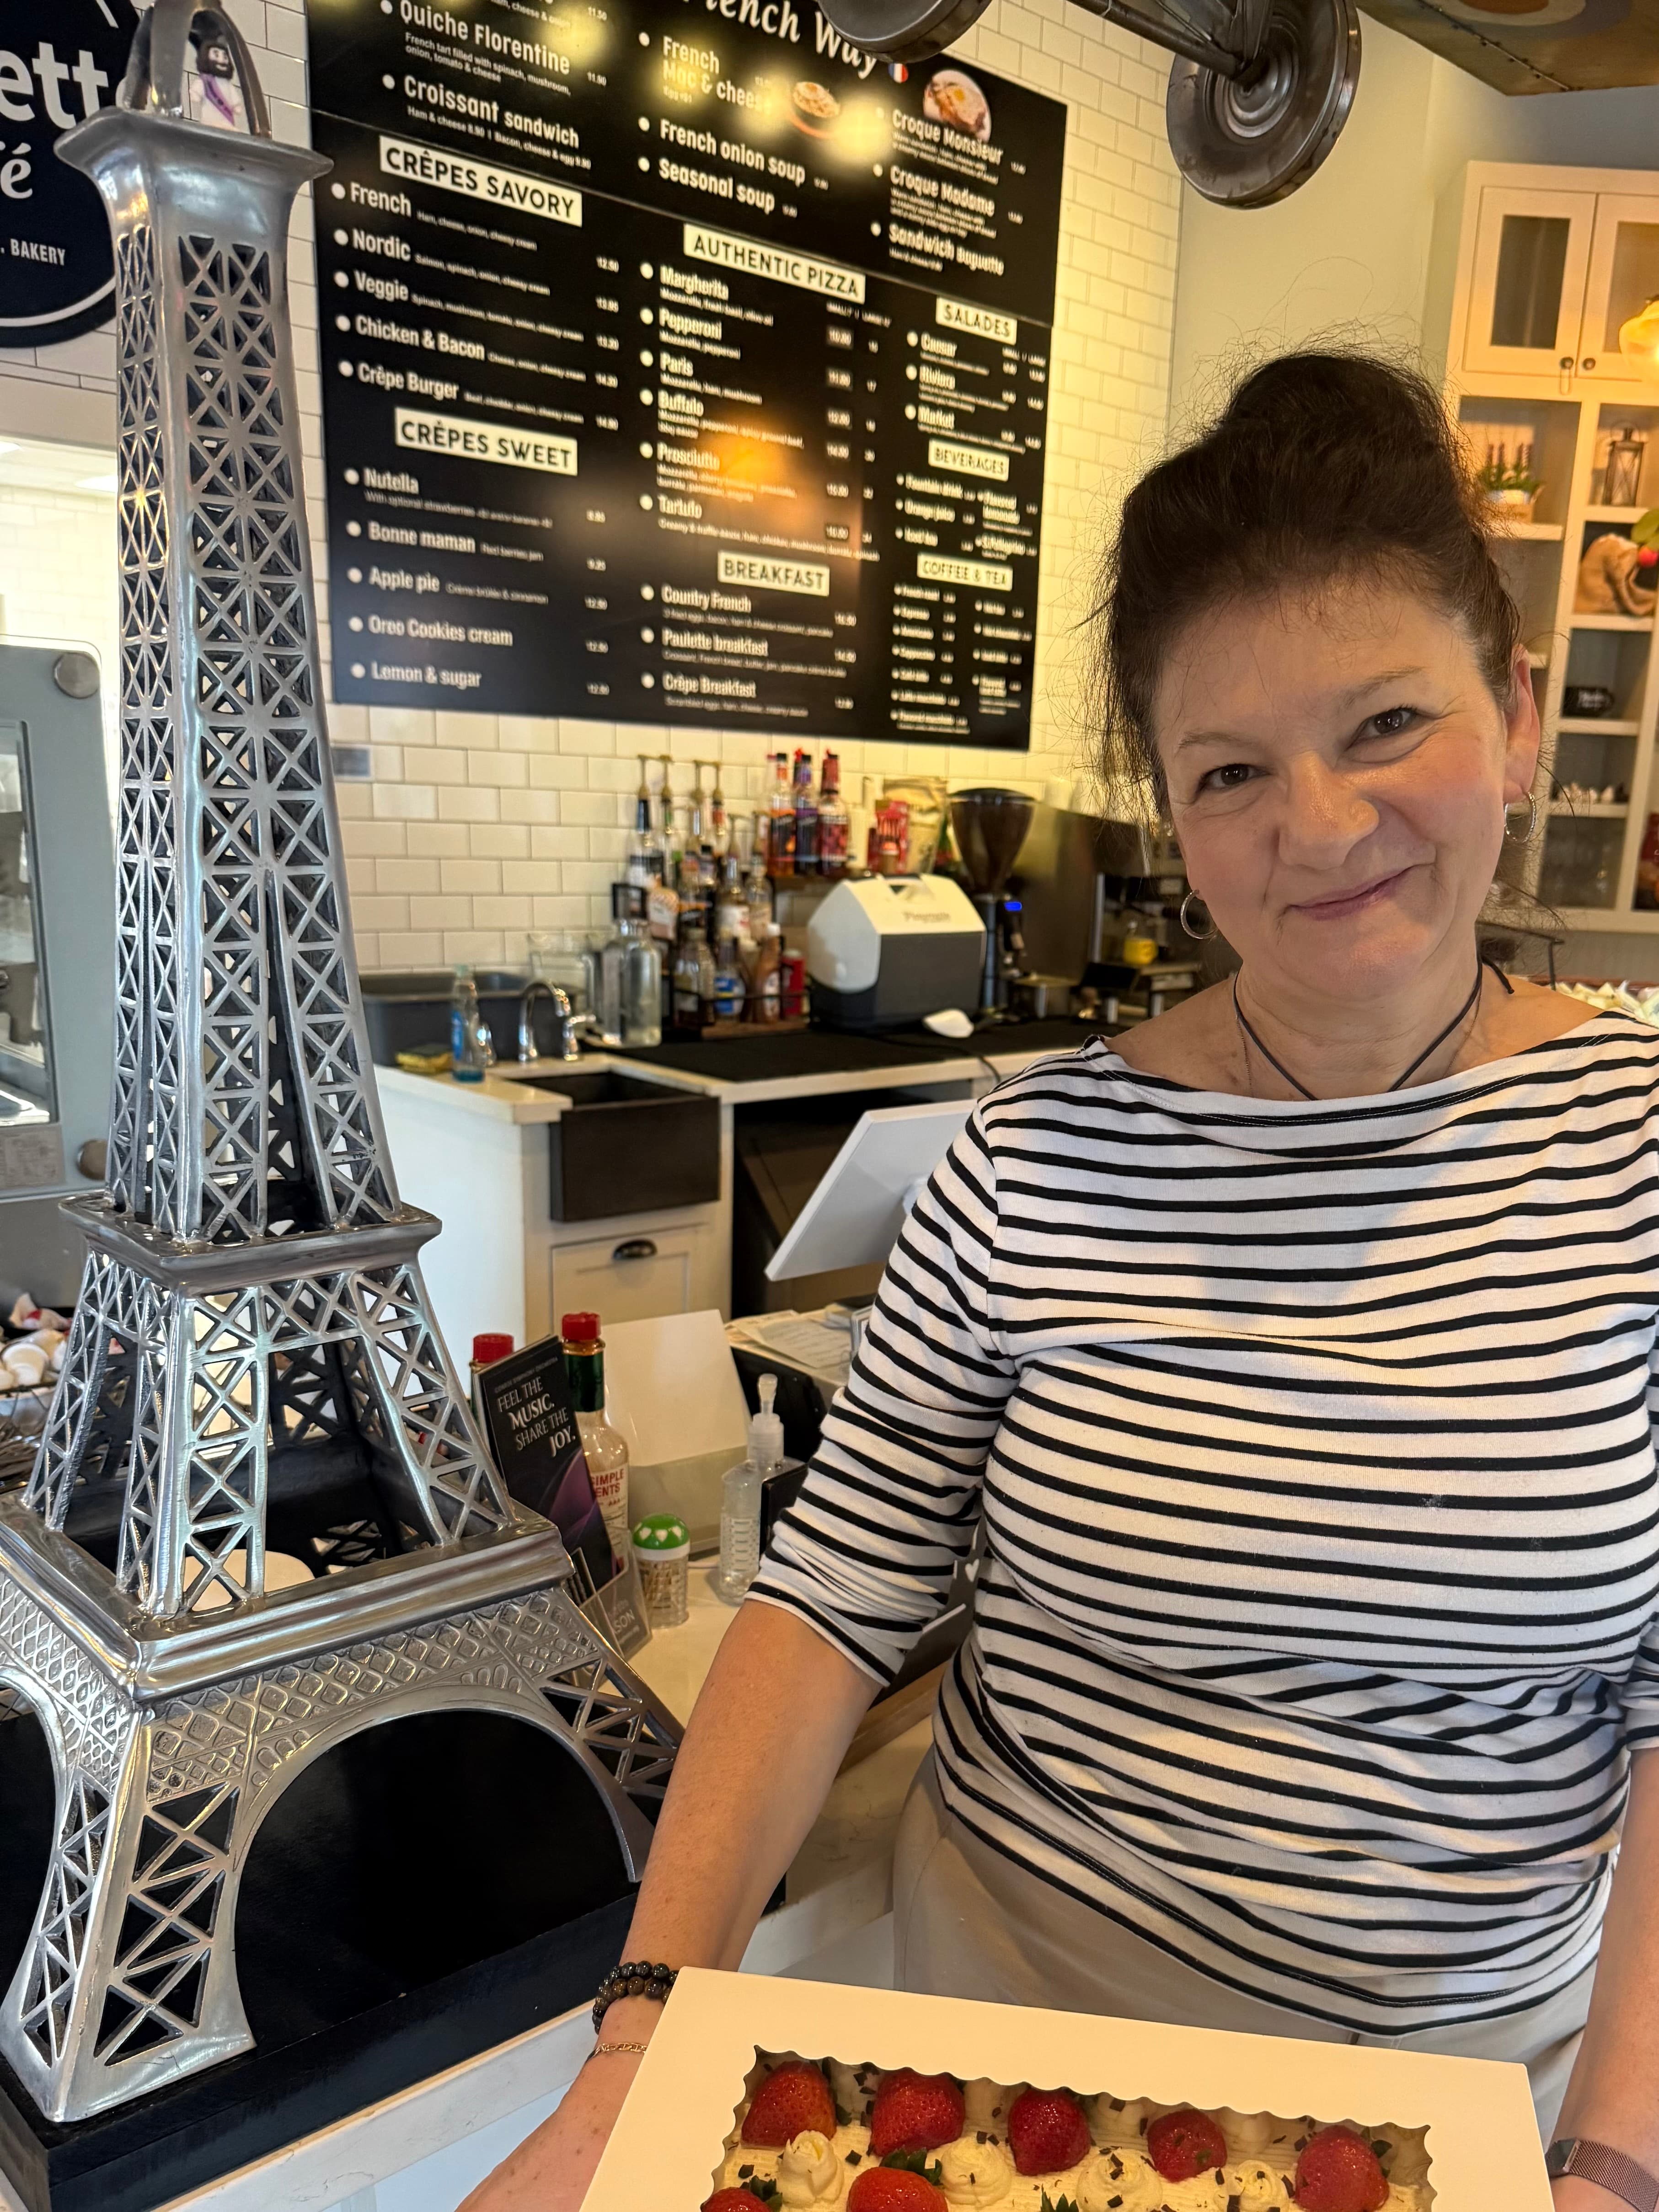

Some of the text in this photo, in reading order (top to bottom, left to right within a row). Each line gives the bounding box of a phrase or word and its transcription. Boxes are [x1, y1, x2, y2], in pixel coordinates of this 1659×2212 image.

[400, 0, 570, 75] Quiche Florentine
[706, 0, 800, 43] ench
[405, 32, 434, 50] French
[436, 42, 451, 55] tart
[453, 47, 473, 63] filled
[474, 54, 492, 69] with
[434, 53, 463, 70] tomato
[465, 62, 471, 73] &
[663, 36, 720, 75] French
[0, 42, 126, 129] ett
[701, 73, 712, 94] &
[717, 80, 772, 116] chees
[404, 75, 579, 149] Croissant sandwich
[407, 105, 428, 122] Ham
[428, 112, 436, 123] &
[893, 109, 941, 142] Croque
[0, 141, 33, 198] é
[660, 118, 717, 156] French
[721, 141, 764, 172] onion
[768, 156, 805, 187] soup
[385, 146, 575, 219] CRÊPES SAVORY
[659, 157, 775, 215] Seasonal soup
[890, 165, 938, 198] Croque
[350, 182, 412, 217] French
[10, 238, 66, 267] BAKERY
[352, 229, 412, 262] Nordic
[693, 234, 859, 297] AUTHENTIC PIZZA
[354, 270, 408, 302] Veggie
[355, 315, 419, 348] Chicken
[422, 329, 435, 350] &
[437, 332, 485, 361] Bacon
[659, 306, 722, 341] Pepperoni
[944, 304, 1010, 337] SALADES
[358, 362, 404, 391] Crêpe
[407, 373, 459, 402] Burger
[401, 419, 573, 469] CRÊPES SWEET
[935, 448, 1004, 474] BEVERAGES
[364, 468, 419, 495] Nutella
[368, 520, 418, 546] Bonne
[419, 530, 476, 553] maman
[369, 565, 413, 591] Apple
[415, 572, 440, 595] pie
[724, 558, 825, 591] BREAKFAST
[923, 560, 969, 580] COFFEE
[987, 570, 1006, 585] TEA
[661, 584, 710, 611] Country
[369, 614, 513, 646] Oreo Cookies cream
[370, 661, 482, 690] Lemon & sugar
[498, 1376, 543, 1413] FEEL THE
[507, 1393, 555, 1430] MUSIC.
[515, 1407, 569, 1451] SHARE THE
[549, 1425, 576, 1457] JOY.
